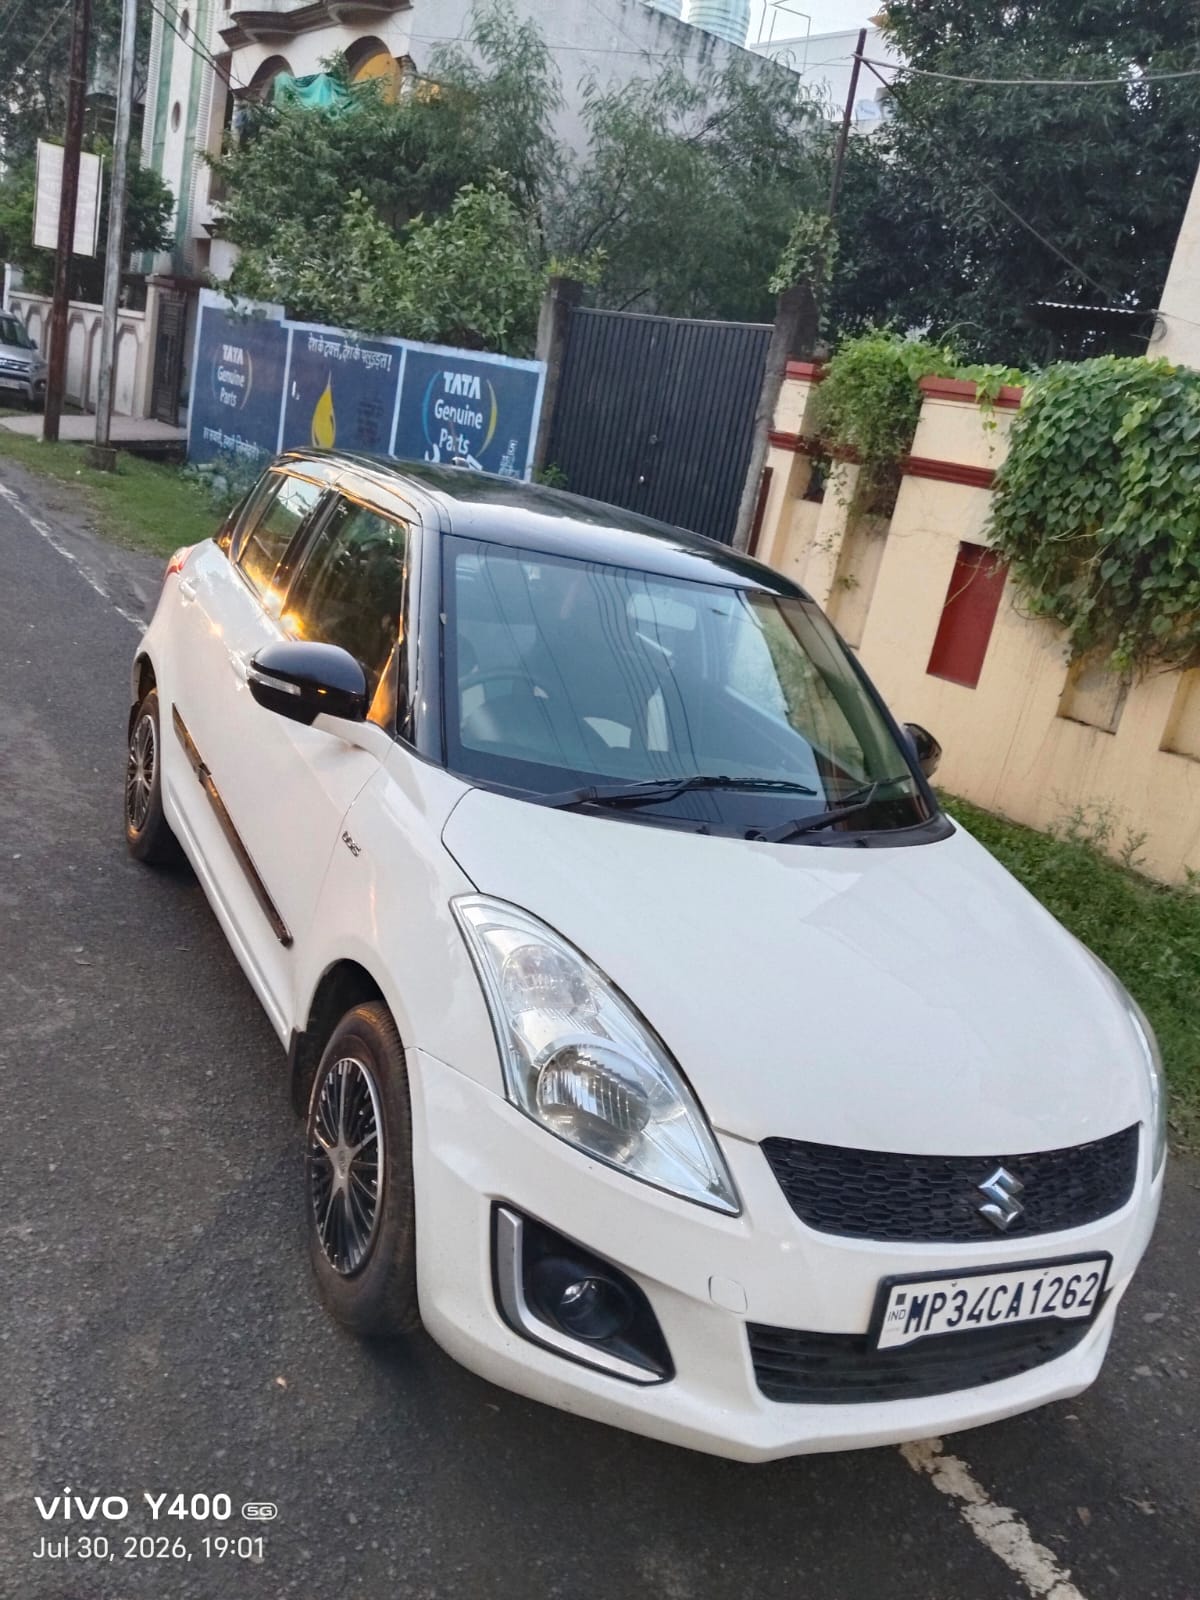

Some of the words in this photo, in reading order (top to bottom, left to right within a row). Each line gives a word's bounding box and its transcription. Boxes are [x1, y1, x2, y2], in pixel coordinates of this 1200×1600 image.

[223, 344, 243, 365] TATA
[443, 371, 480, 400] TATA
[434, 398, 483, 430] Genuine
[887, 1309, 906, 1322] IND
[903, 1271, 1100, 1334] MP34CA1262
